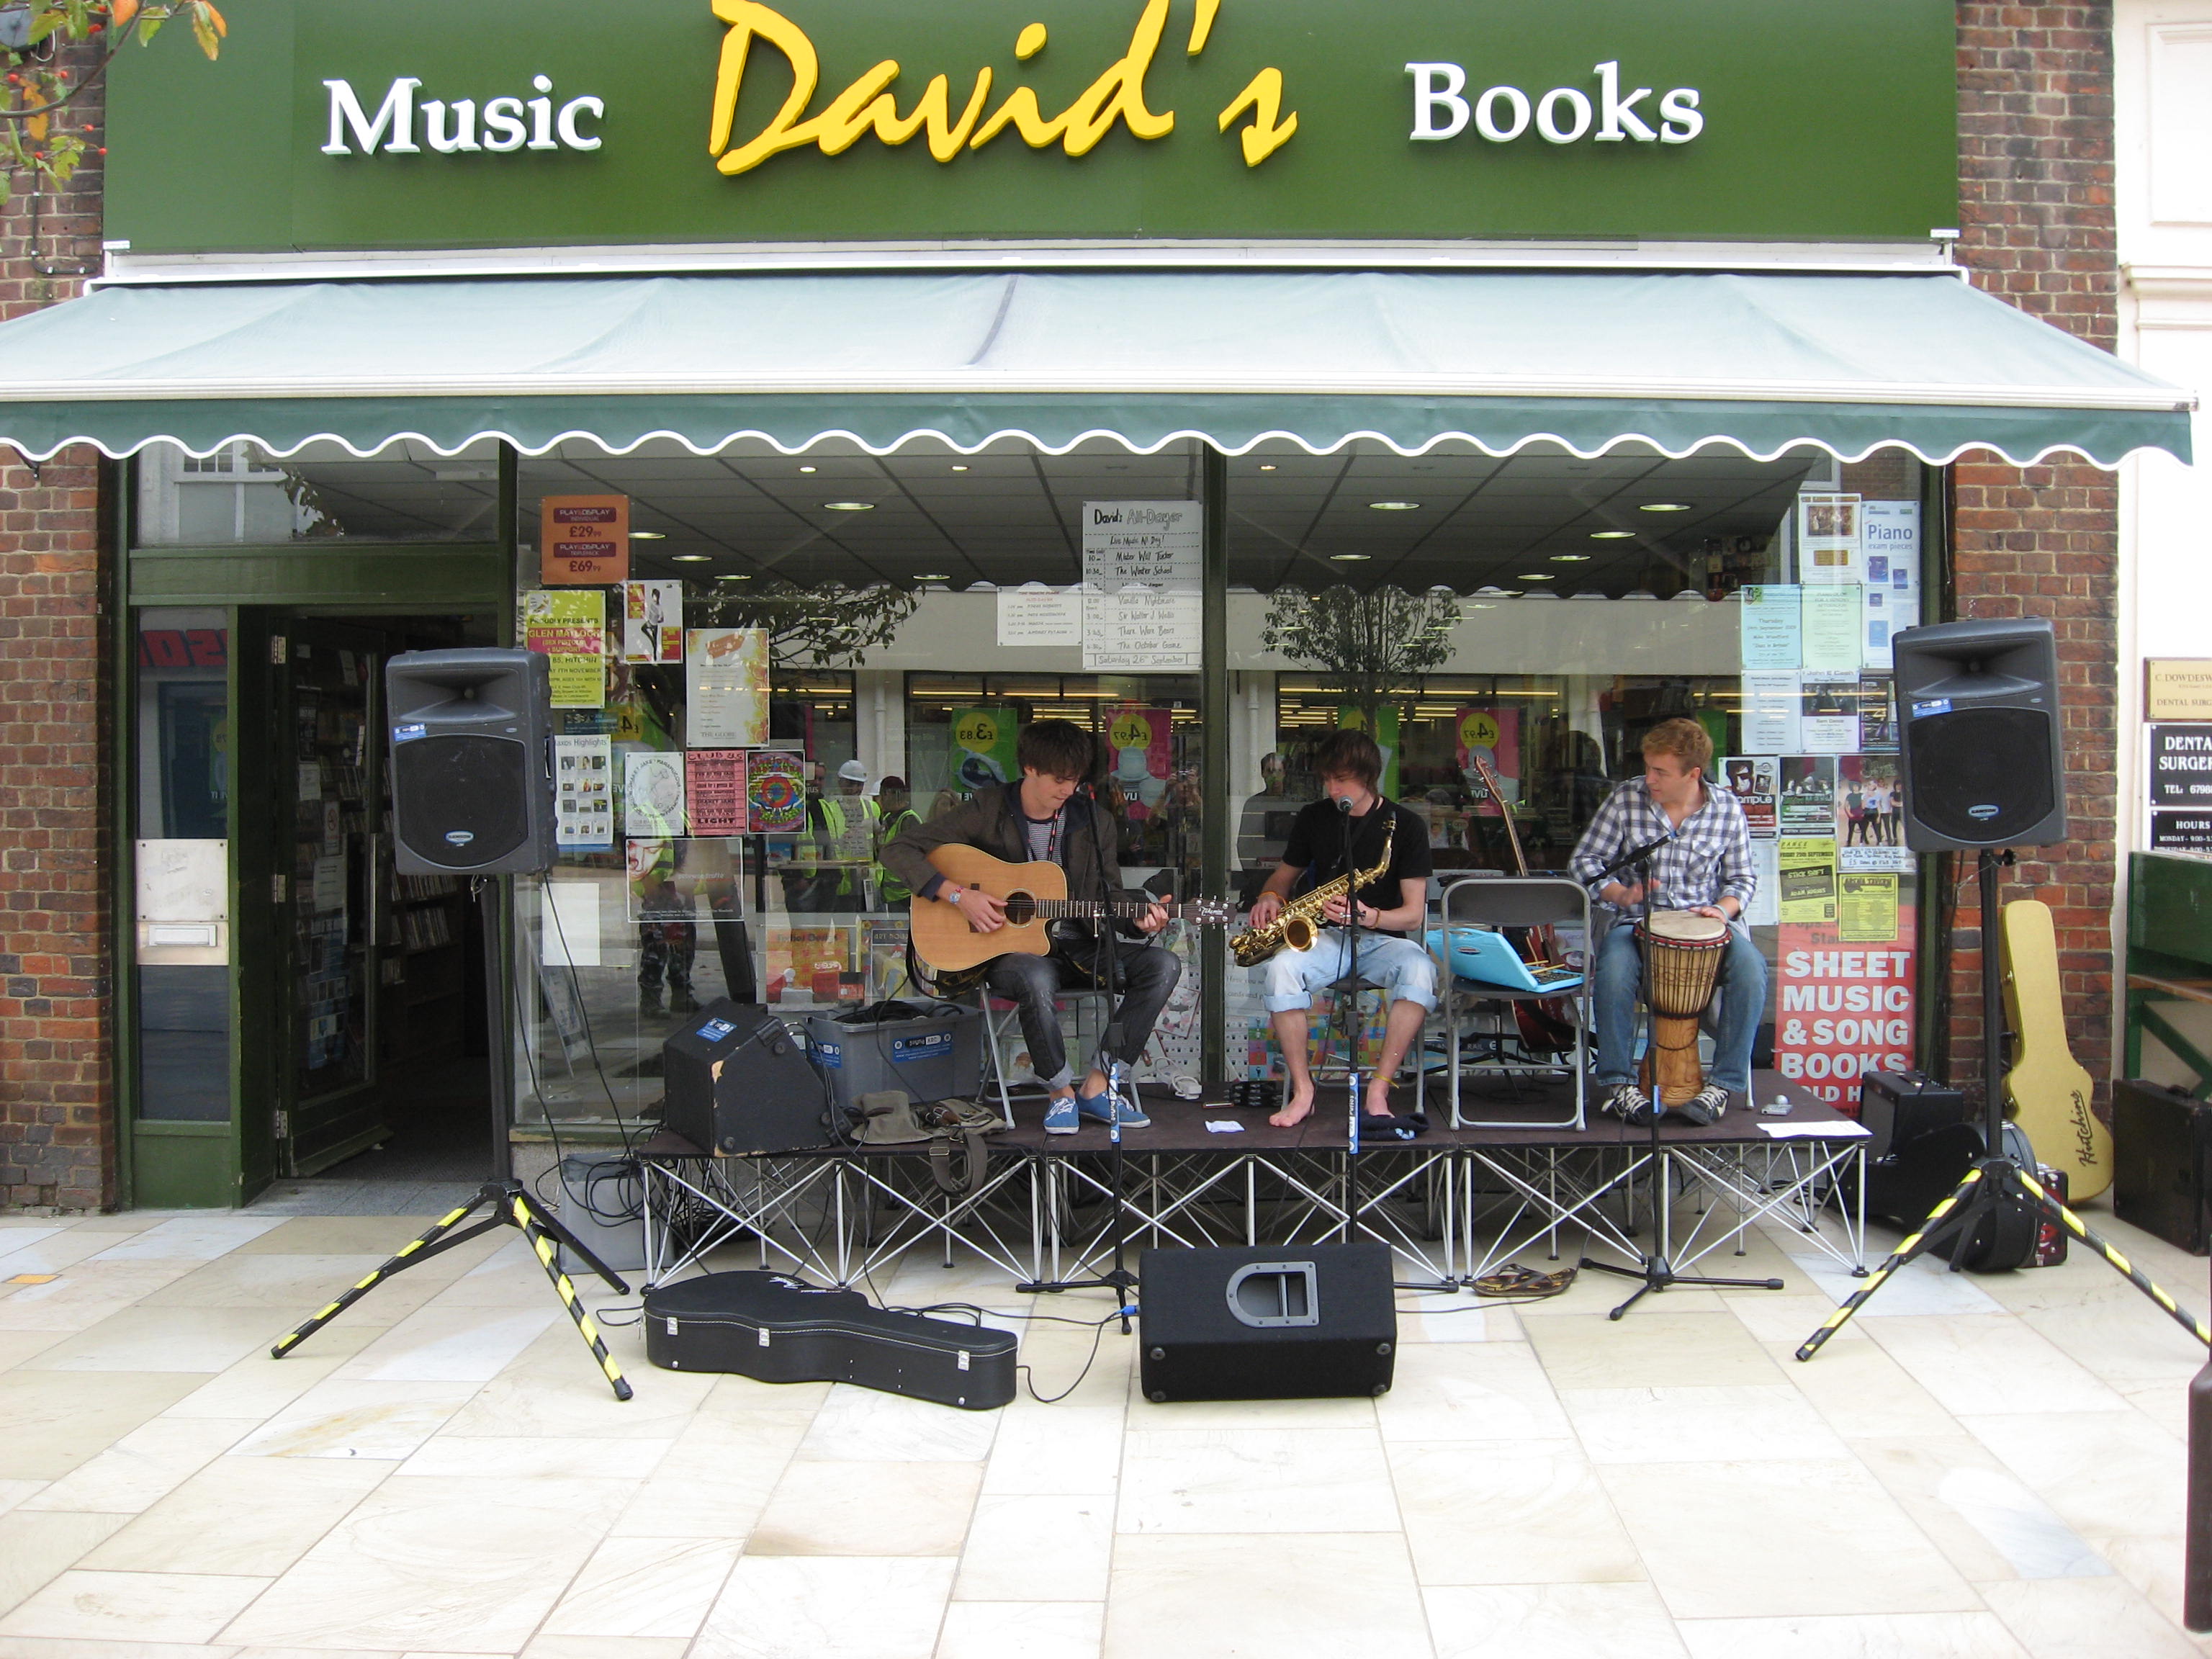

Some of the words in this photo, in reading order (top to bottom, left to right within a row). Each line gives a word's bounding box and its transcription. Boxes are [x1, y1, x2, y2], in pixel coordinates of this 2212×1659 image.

[710, 0, 1297, 175] David's
[1405, 60, 1704, 144] Books
[321, 74, 604, 155] Music
[1868, 524, 1912, 540] Piano
[1889, 542, 1912, 552] pieces
[1115, 566, 1127, 575] The
[1118, 642, 1130, 650] The
[1099, 656, 1130, 666] Saturday
[1152, 655, 1184, 665] September
[574, 737, 607, 747] Highlights
[688, 752, 723, 760] CLUB
[2159, 756, 2212, 770] SURGE
[1737, 796, 1772, 805] ample
[2176, 821, 2211, 830] HOURS
[1784, 950, 1911, 978] SHEET
[1783, 985, 1910, 1012] MUSIC
[1782, 1018, 1807, 1046] &
[1812, 1019, 1908, 1046] SONG
[1781, 1053, 1907, 1079] BOOKS
[2070, 1089, 2098, 1166] Hutchins
